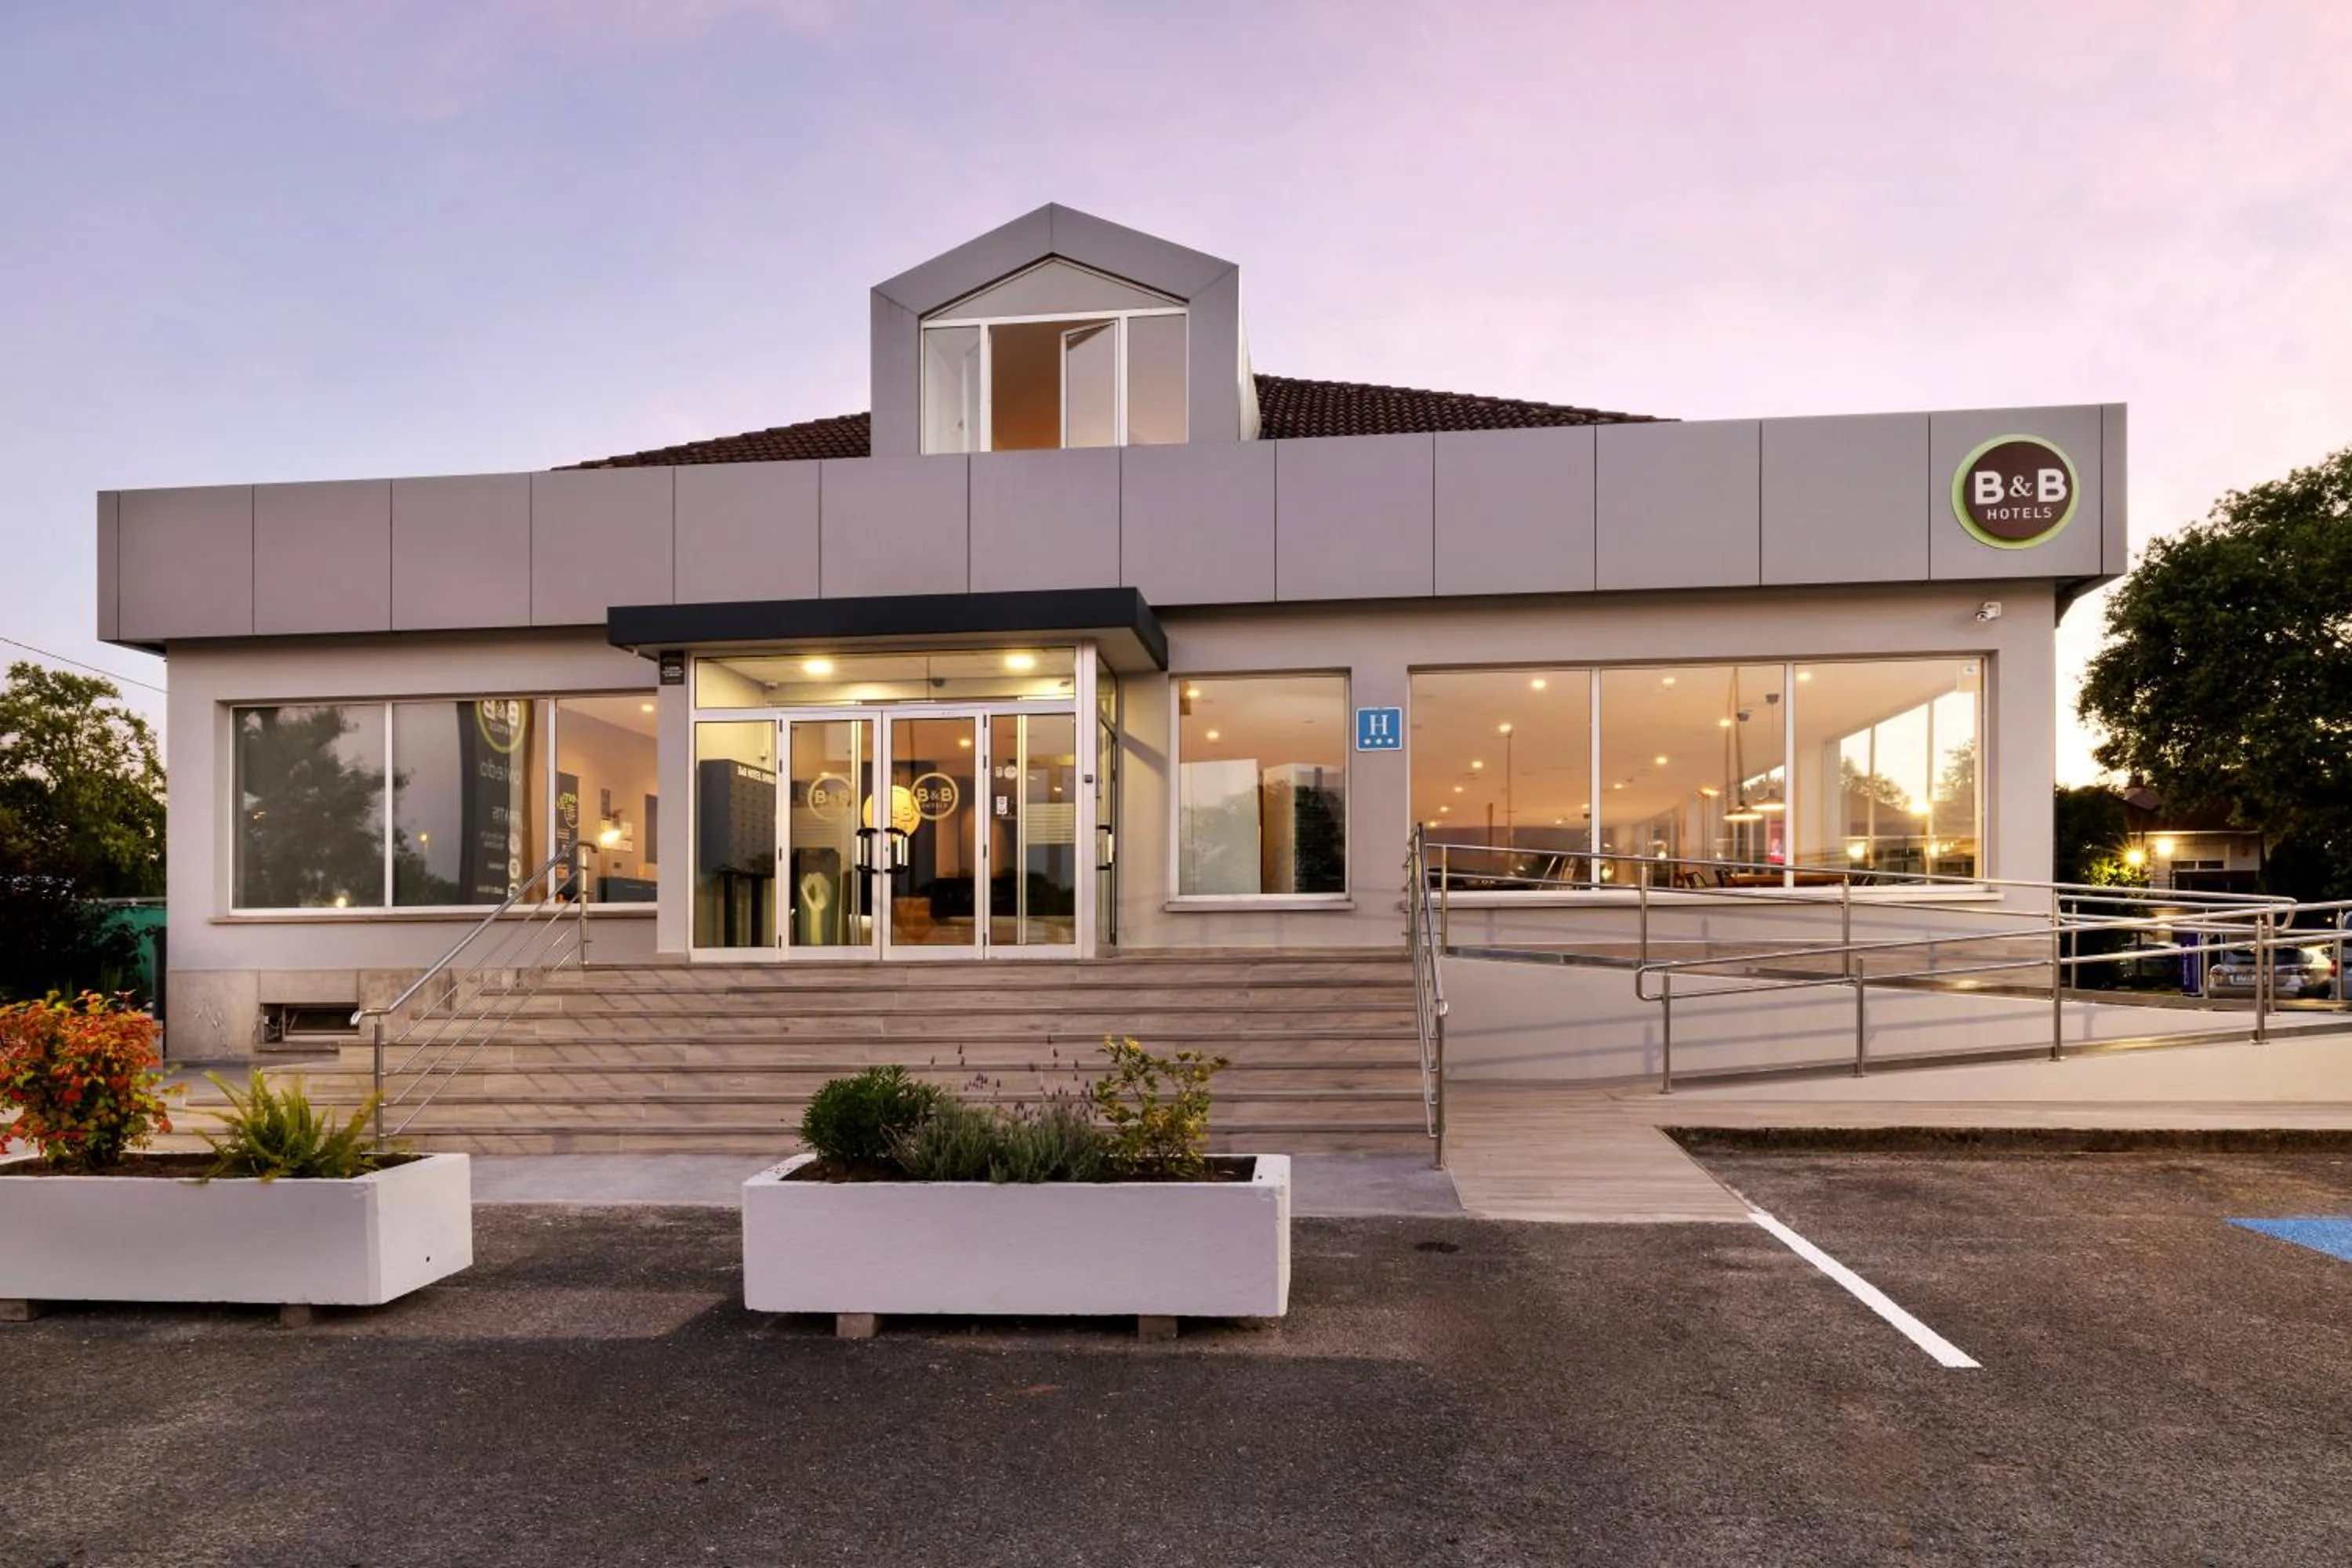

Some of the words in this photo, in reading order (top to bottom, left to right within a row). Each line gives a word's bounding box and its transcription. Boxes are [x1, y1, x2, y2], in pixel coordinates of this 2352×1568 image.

[1974, 468, 2067, 505] B&B
[1986, 507, 2053, 521] HOTELS
[1370, 714, 1388, 736] H
[916, 787, 953, 802] B&B
